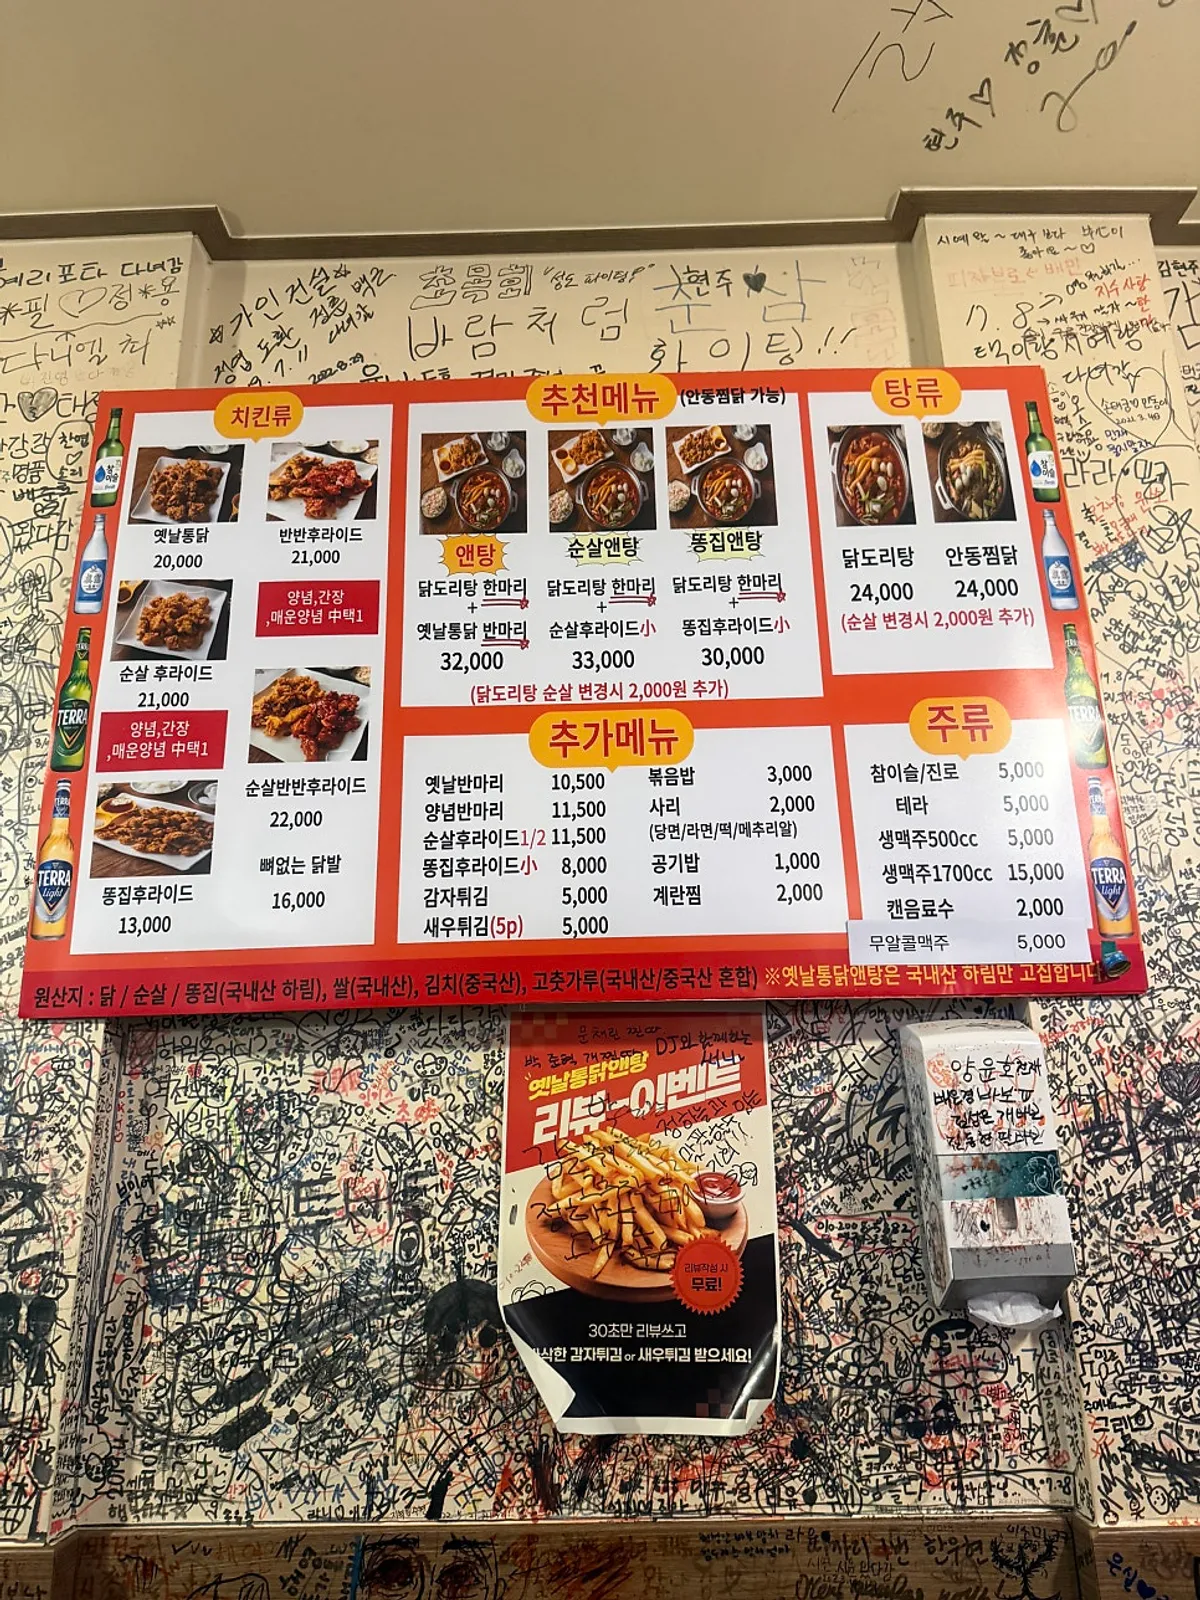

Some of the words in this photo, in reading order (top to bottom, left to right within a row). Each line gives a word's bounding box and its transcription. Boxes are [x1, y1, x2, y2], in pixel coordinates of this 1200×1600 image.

[541, 382, 660, 418] 추천메뉴
[680, 388, 746, 407] (안동찜닭
[749, 386, 786, 407] 가능)
[885, 377, 943, 409] 탕류
[231, 405, 293, 428] 치킨류
[153, 527, 210, 544] 옛날통닭
[279, 526, 364, 544] 반반후라이드
[691, 531, 763, 554] 똥집앤탕
[291, 549, 341, 567] 21,000
[455, 543, 496, 568] 앤탕
[568, 536, 639, 559] 순살앤탕
[841, 546, 915, 569] 닭도리탕
[945, 545, 1018, 567] 안동찜닭
[153, 554, 204, 571] 20,000
[418, 579, 479, 598] 닭도리탕
[483, 577, 527, 599] 한마리
[547, 578, 606, 598] 닭도리탕
[612, 576, 655, 598] 한마리
[672, 575, 733, 594] 닭도리탕
[737, 573, 782, 593] 한마리
[849, 582, 914, 605] 24,000
[954, 578, 1019, 601] 24,000
[287, 590, 345, 607] 양념,간장
[328, 609, 364, 625] 中택1
[841, 612, 876, 633] (순살
[882, 610, 929, 630] 변경시
[933, 609, 994, 630] 2,000원
[998, 607, 1036, 627] 추가)
[417, 622, 478, 641] 옛날통닭
[483, 620, 527, 641] 반마리
[440, 651, 504, 673] 32,000
[571, 650, 635, 673] 33,000
[701, 646, 765, 668] 30,000
[119, 667, 150, 684] 순살
[153, 664, 214, 682] 후라이드
[137, 691, 190, 711] 21,000
[470, 684, 537, 705] (닭도리탕
[542, 683, 574, 702] 순살
[578, 682, 625, 701] 변경시
[629, 680, 687, 701] 2,000원
[692, 679, 729, 700] 추가)
[58, 707, 89, 727] TERRA
[927, 703, 994, 743] 주류
[1066, 705, 1100, 723] TERRA
[130, 720, 190, 738] 양념,간장
[549, 718, 680, 759] 추가메뉴
[171, 740, 209, 759] 中택1
[424, 774, 504, 795] 옛날반마리
[551, 772, 606, 795] 10,500
[648, 766, 696, 786] 볶음밥
[766, 765, 813, 786] 3,000
[870, 763, 960, 785] 참이슬/진로
[998, 761, 1045, 779] 5,000
[245, 777, 367, 798] 순살반반후라이드
[424, 801, 504, 823] 양념반마리
[551, 800, 607, 822] 11,500
[649, 797, 681, 817] 사리
[770, 795, 816, 816] 2,000
[896, 796, 929, 816] 테라
[1003, 795, 1049, 813] 5,000
[269, 810, 323, 831] 22,000
[648, 820, 798, 842] (당면/라면/떡/메추리알)
[422, 828, 547, 850] 순살후라이드1/2
[551, 827, 607, 849] 11,500
[878, 830, 979, 850] 생맥주500cc
[1008, 828, 1055, 847] 5,000
[260, 856, 306, 876] 뼈없는
[311, 855, 342, 874] 닭발
[561, 855, 608, 878] 8,000
[652, 853, 700, 875] 공기밥
[775, 852, 821, 873] 1,000
[882, 863, 994, 884] 생맥주1700cc
[1008, 862, 1065, 882] 15,000
[37, 868, 72, 888] TERRA
[1091, 866, 1127, 885] TERRA
[102, 884, 194, 906] 똥집후라이드
[271, 890, 326, 912] 16,000
[423, 886, 489, 908] 감자튀김
[561, 886, 609, 908] 5,000
[653, 885, 703, 906] 계란찜
[776, 884, 824, 904] 2,000
[886, 898, 955, 920] 캔음료수
[1016, 897, 1065, 917] 2,000
[118, 915, 172, 936] 13,000
[423, 915, 524, 939] 새우튀김(5p)
[562, 915, 610, 938] 5,000
[868, 934, 951, 953] 무알콜맥주
[1017, 933, 1067, 950] 5,000
[35, 985, 83, 1009] 원산지
[100, 984, 116, 1006] 닭
[133, 983, 168, 1005] 순살
[184, 980, 277, 1006] 똥집(국내산
[282, 977, 327, 1003] 하림),
[332, 975, 420, 1002] 쌀(국내산),
[424, 970, 527, 996] 김치(중국산),
[531, 966, 713, 993] 고춧가루(국내산/중국산
[718, 966, 758, 991] 혼합)
[905, 965, 957, 986] 국내산
[962, 963, 1013, 985] 하림만
[528, 1050, 650, 1101] 옛날통닭앤탕
[684, 1262, 719, 1274] 리뷰작성
[690, 1276, 723, 1293] 무료!
[588, 1324, 634, 1339] 30초만
[636, 1323, 687, 1339] 리뷰쓰고
[570, 1347, 623, 1363] 감자튀김
[624, 1352, 636, 1362] or
[637, 1347, 691, 1363] 새우튀김
[694, 1346, 752, 1364] 받으세요!
